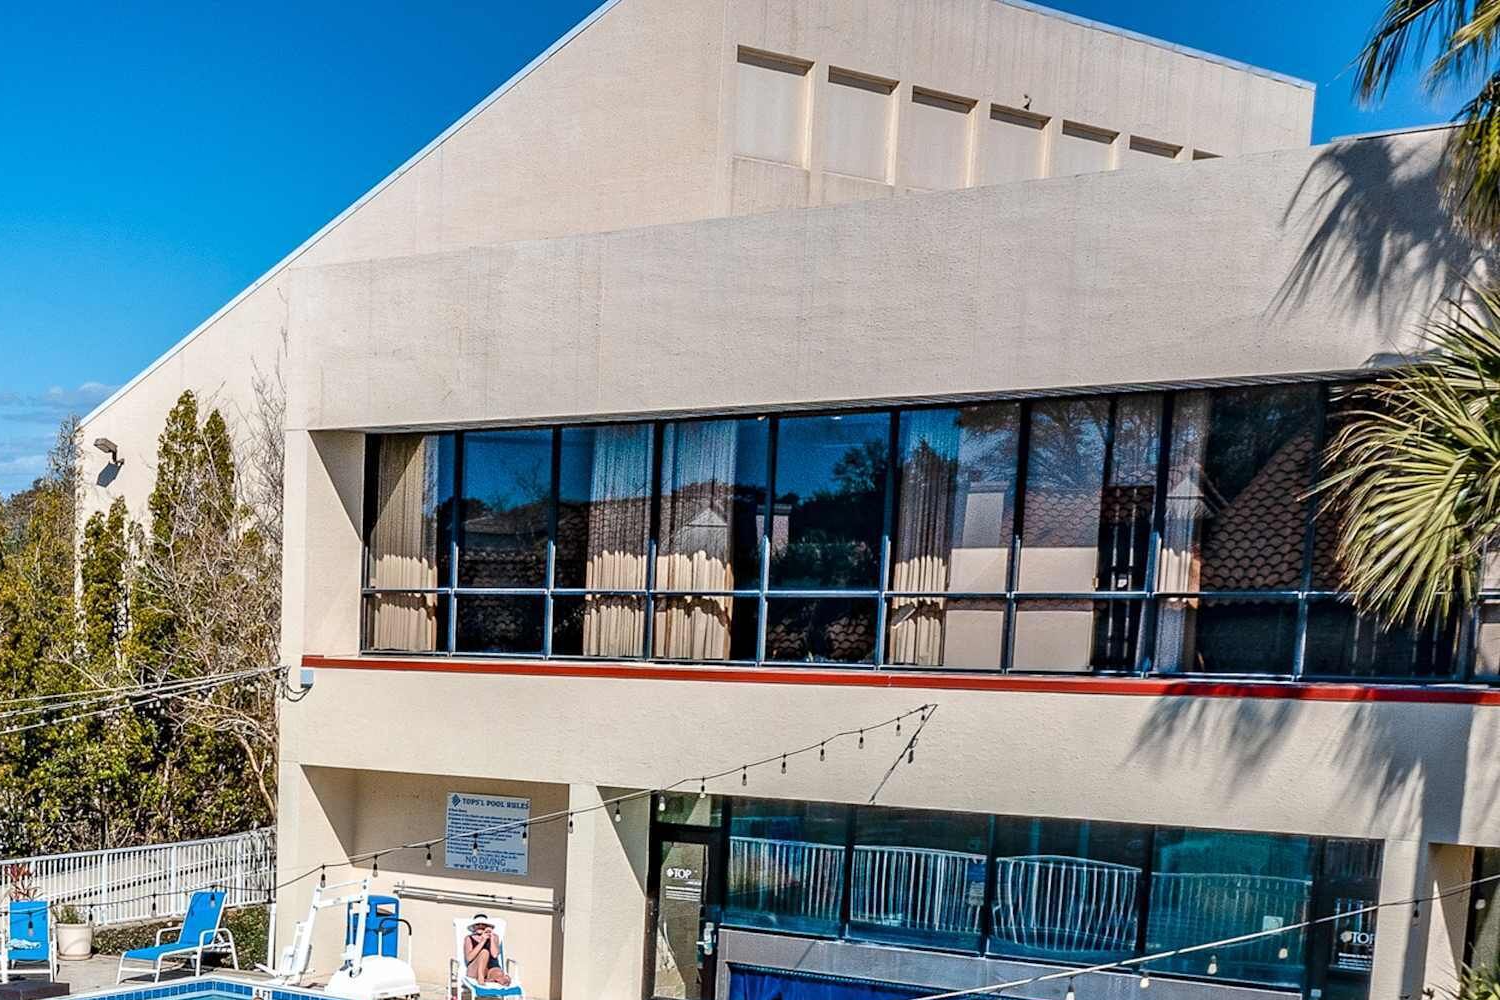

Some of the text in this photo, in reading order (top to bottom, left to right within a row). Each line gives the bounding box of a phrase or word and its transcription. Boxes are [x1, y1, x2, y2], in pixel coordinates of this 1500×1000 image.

[486, 800, 504, 808] POOL
[506, 802, 528, 810] RULES
[465, 856, 506, 867] NO DIVING
